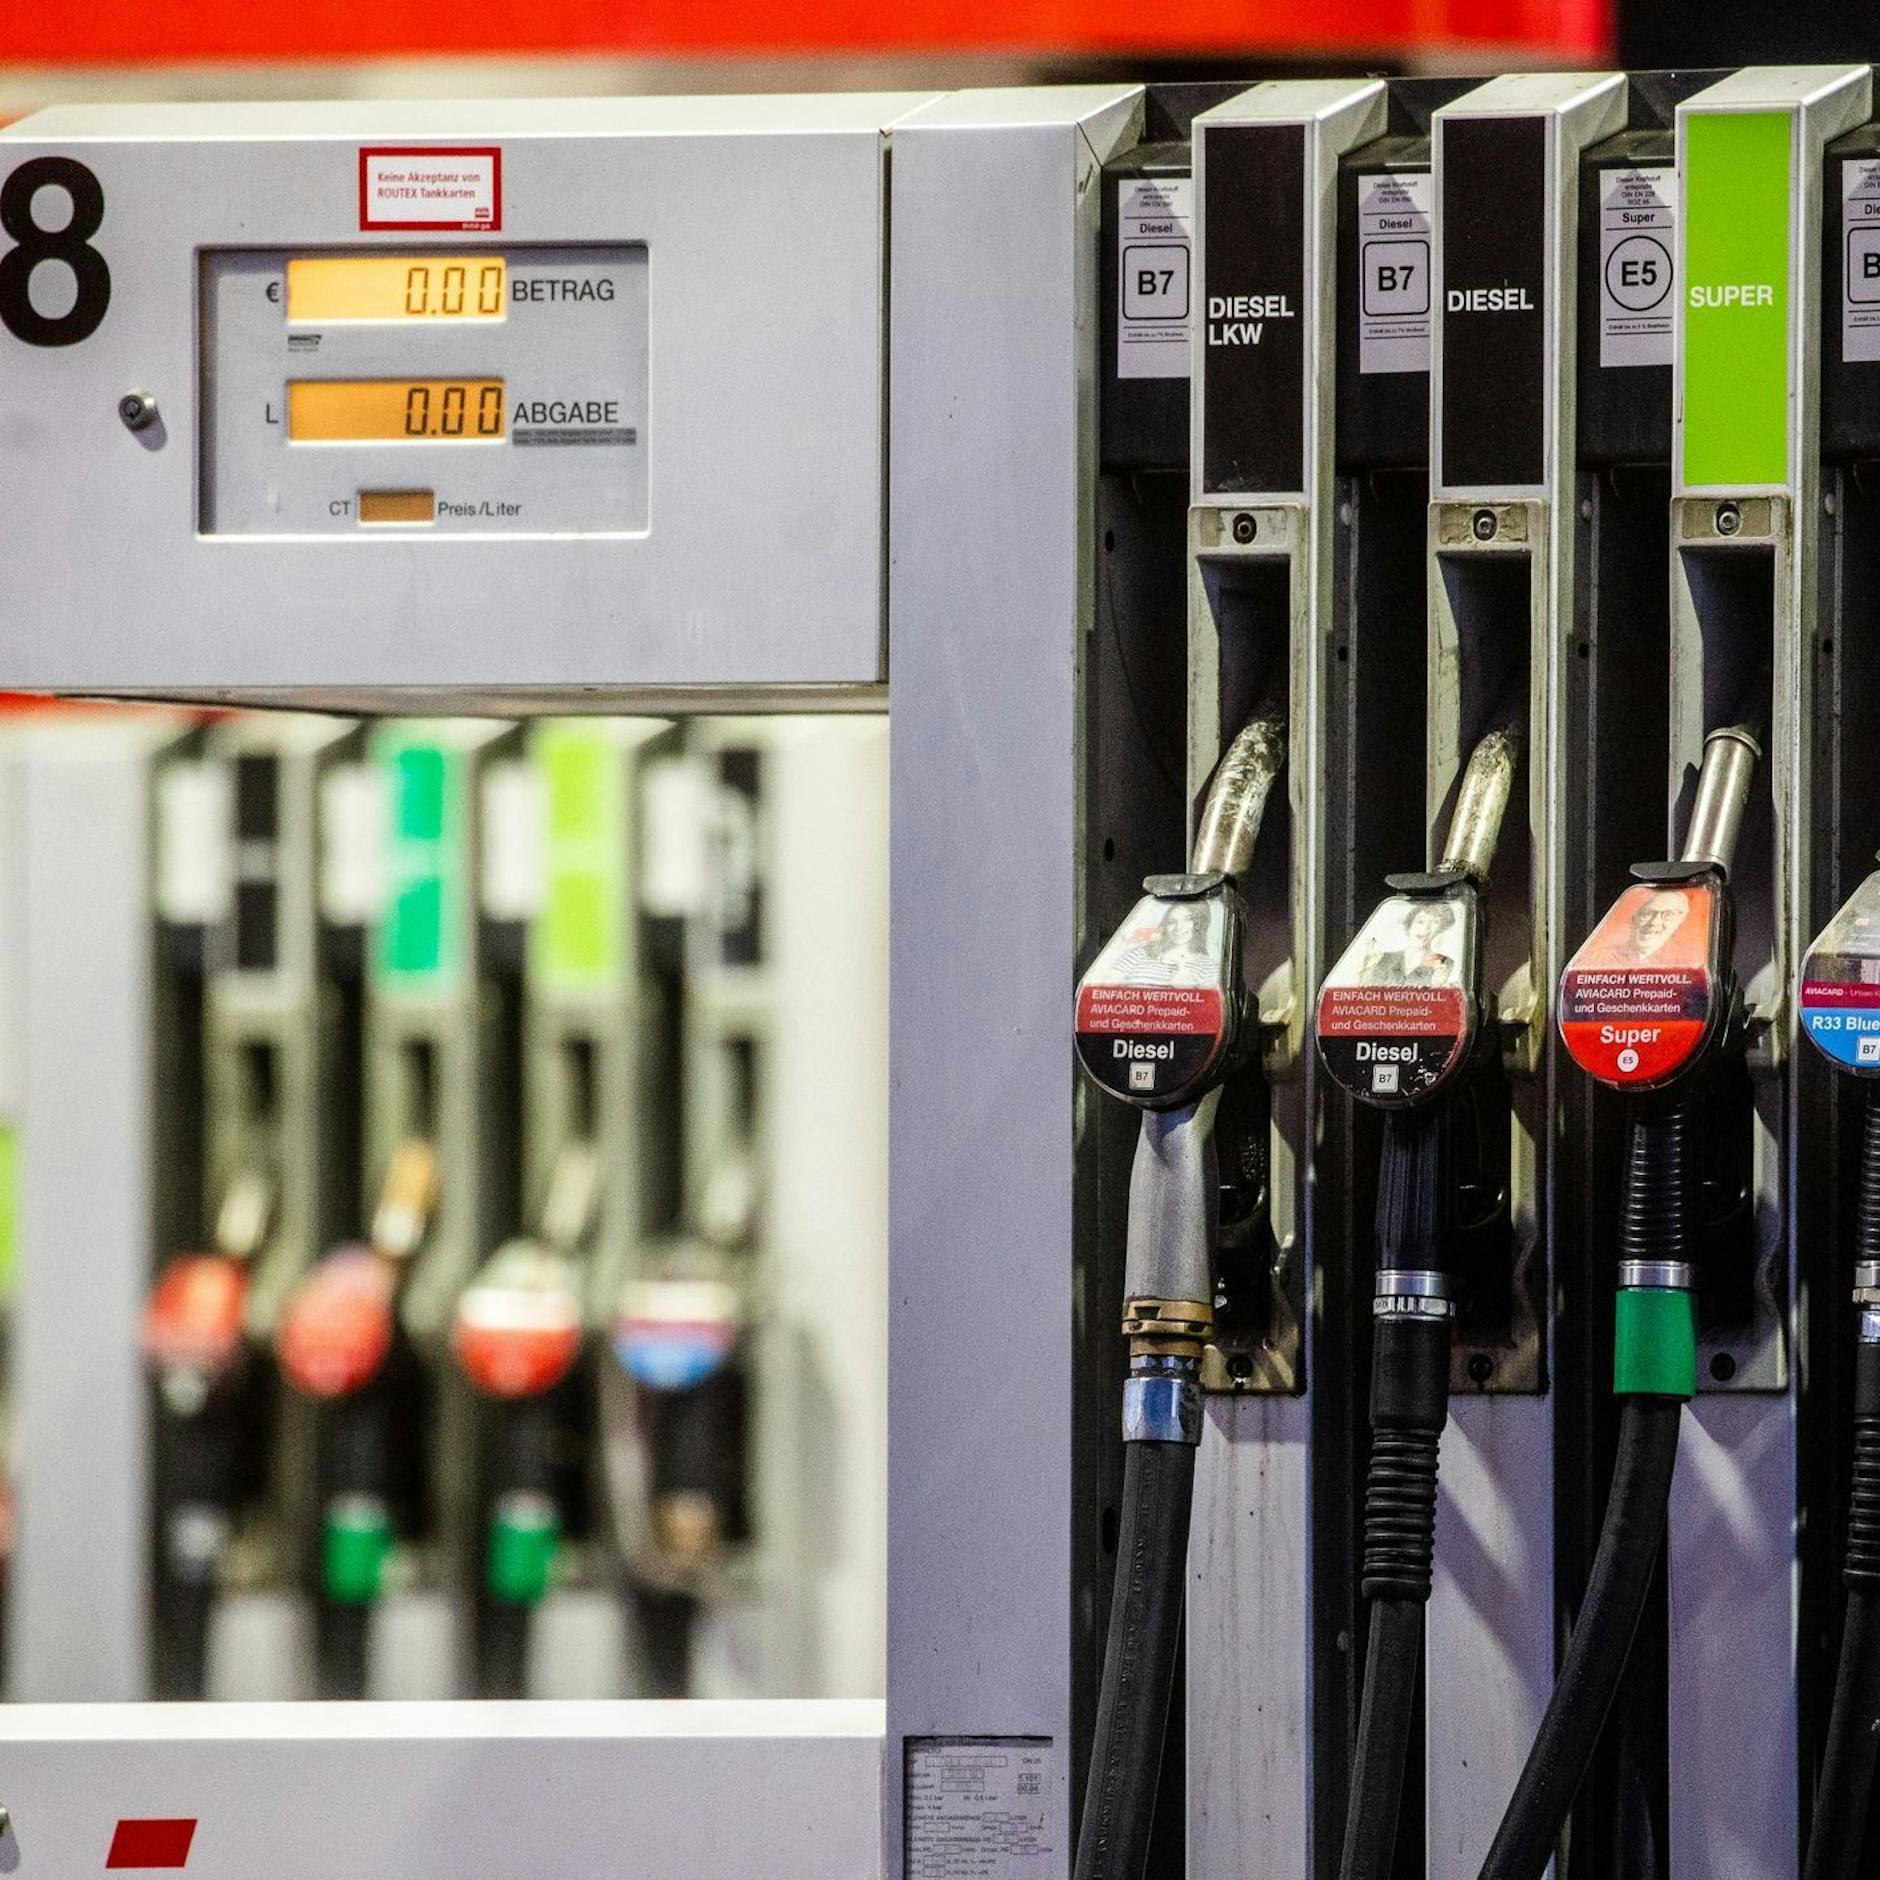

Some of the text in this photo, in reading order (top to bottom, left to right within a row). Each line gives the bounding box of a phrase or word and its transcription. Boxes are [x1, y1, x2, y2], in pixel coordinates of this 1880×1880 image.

[377, 171, 481, 185] Keine Akzeptanz von
[377, 187, 476, 199] ROUTEX Tankkarten
[1379, 218, 1413, 230] Diesel
[1622, 212, 1655, 225] Super
[1140, 223, 1173, 234] Diesel
[0, 156, 111, 347] 8
[1378, 266, 1414, 291] B7
[1621, 260, 1658, 287] E5
[1138, 270, 1174, 295] B7
[265, 282, 280, 303] €
[406, 267, 502, 315] 0.00
[511, 279, 614, 302] BETRAG
[1690, 284, 1774, 308] SUPER
[1208, 295, 1295, 319] DIESEL
[1447, 288, 1534, 311] DIESEL
[1208, 322, 1263, 346] LKW
[265, 403, 279, 424] L
[404, 387, 502, 436] 0.00
[512, 401, 619, 423] ABGABE
[329, 501, 351, 516] CT
[437, 501, 476, 516] Preis
[1576, 974, 1692, 985] EINFACH WERTVOLL.
[1091, 989, 1205, 1003] EINFACH WERTVOLL.
[1333, 991, 1380, 1001] EINFACH
[1575, 988, 1677, 1001] AVIACARD Prepaid-
[1805, 987, 1844, 997] AVIACARD
[1090, 1003, 1191, 1017] AVIACARD Prepaid-
[1331, 1005, 1432, 1018] AVIACARD Prepaid-
[1574, 1002, 1681, 1013] und Geschenkkarten
[1089, 1019, 1194, 1032] und Geschenkkarten
[1331, 1020, 1436, 1031] und Geschenkkarten
[1812, 1015, 1880, 1030] R33 Blue
[1600, 1025, 1662, 1048] Super
[1112, 1039, 1175, 1060] Diesel
[1355, 1041, 1419, 1061] Diesel
[1862, 1044, 1877, 1055] B7
[1135, 1072, 1149, 1081] B7
[1379, 1074, 1392, 1083] B7
